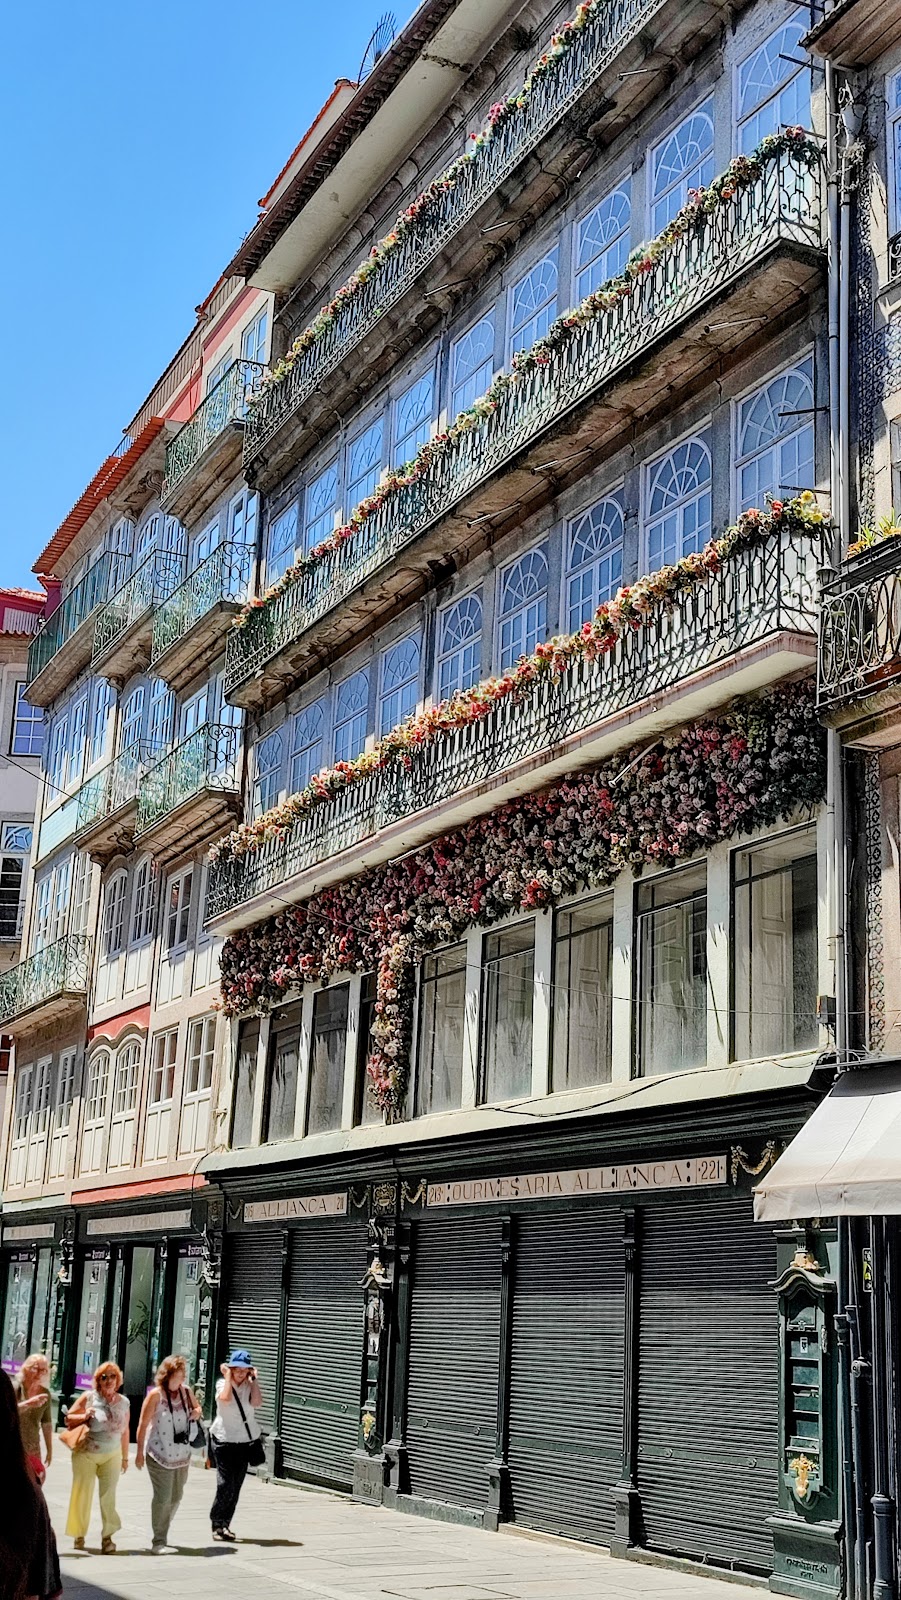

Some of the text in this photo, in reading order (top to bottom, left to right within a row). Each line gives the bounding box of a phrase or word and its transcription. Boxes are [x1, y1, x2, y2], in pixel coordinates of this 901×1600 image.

[429, 1160, 720, 1204] 213 OURIVESARIA ALLIANÇA 221
